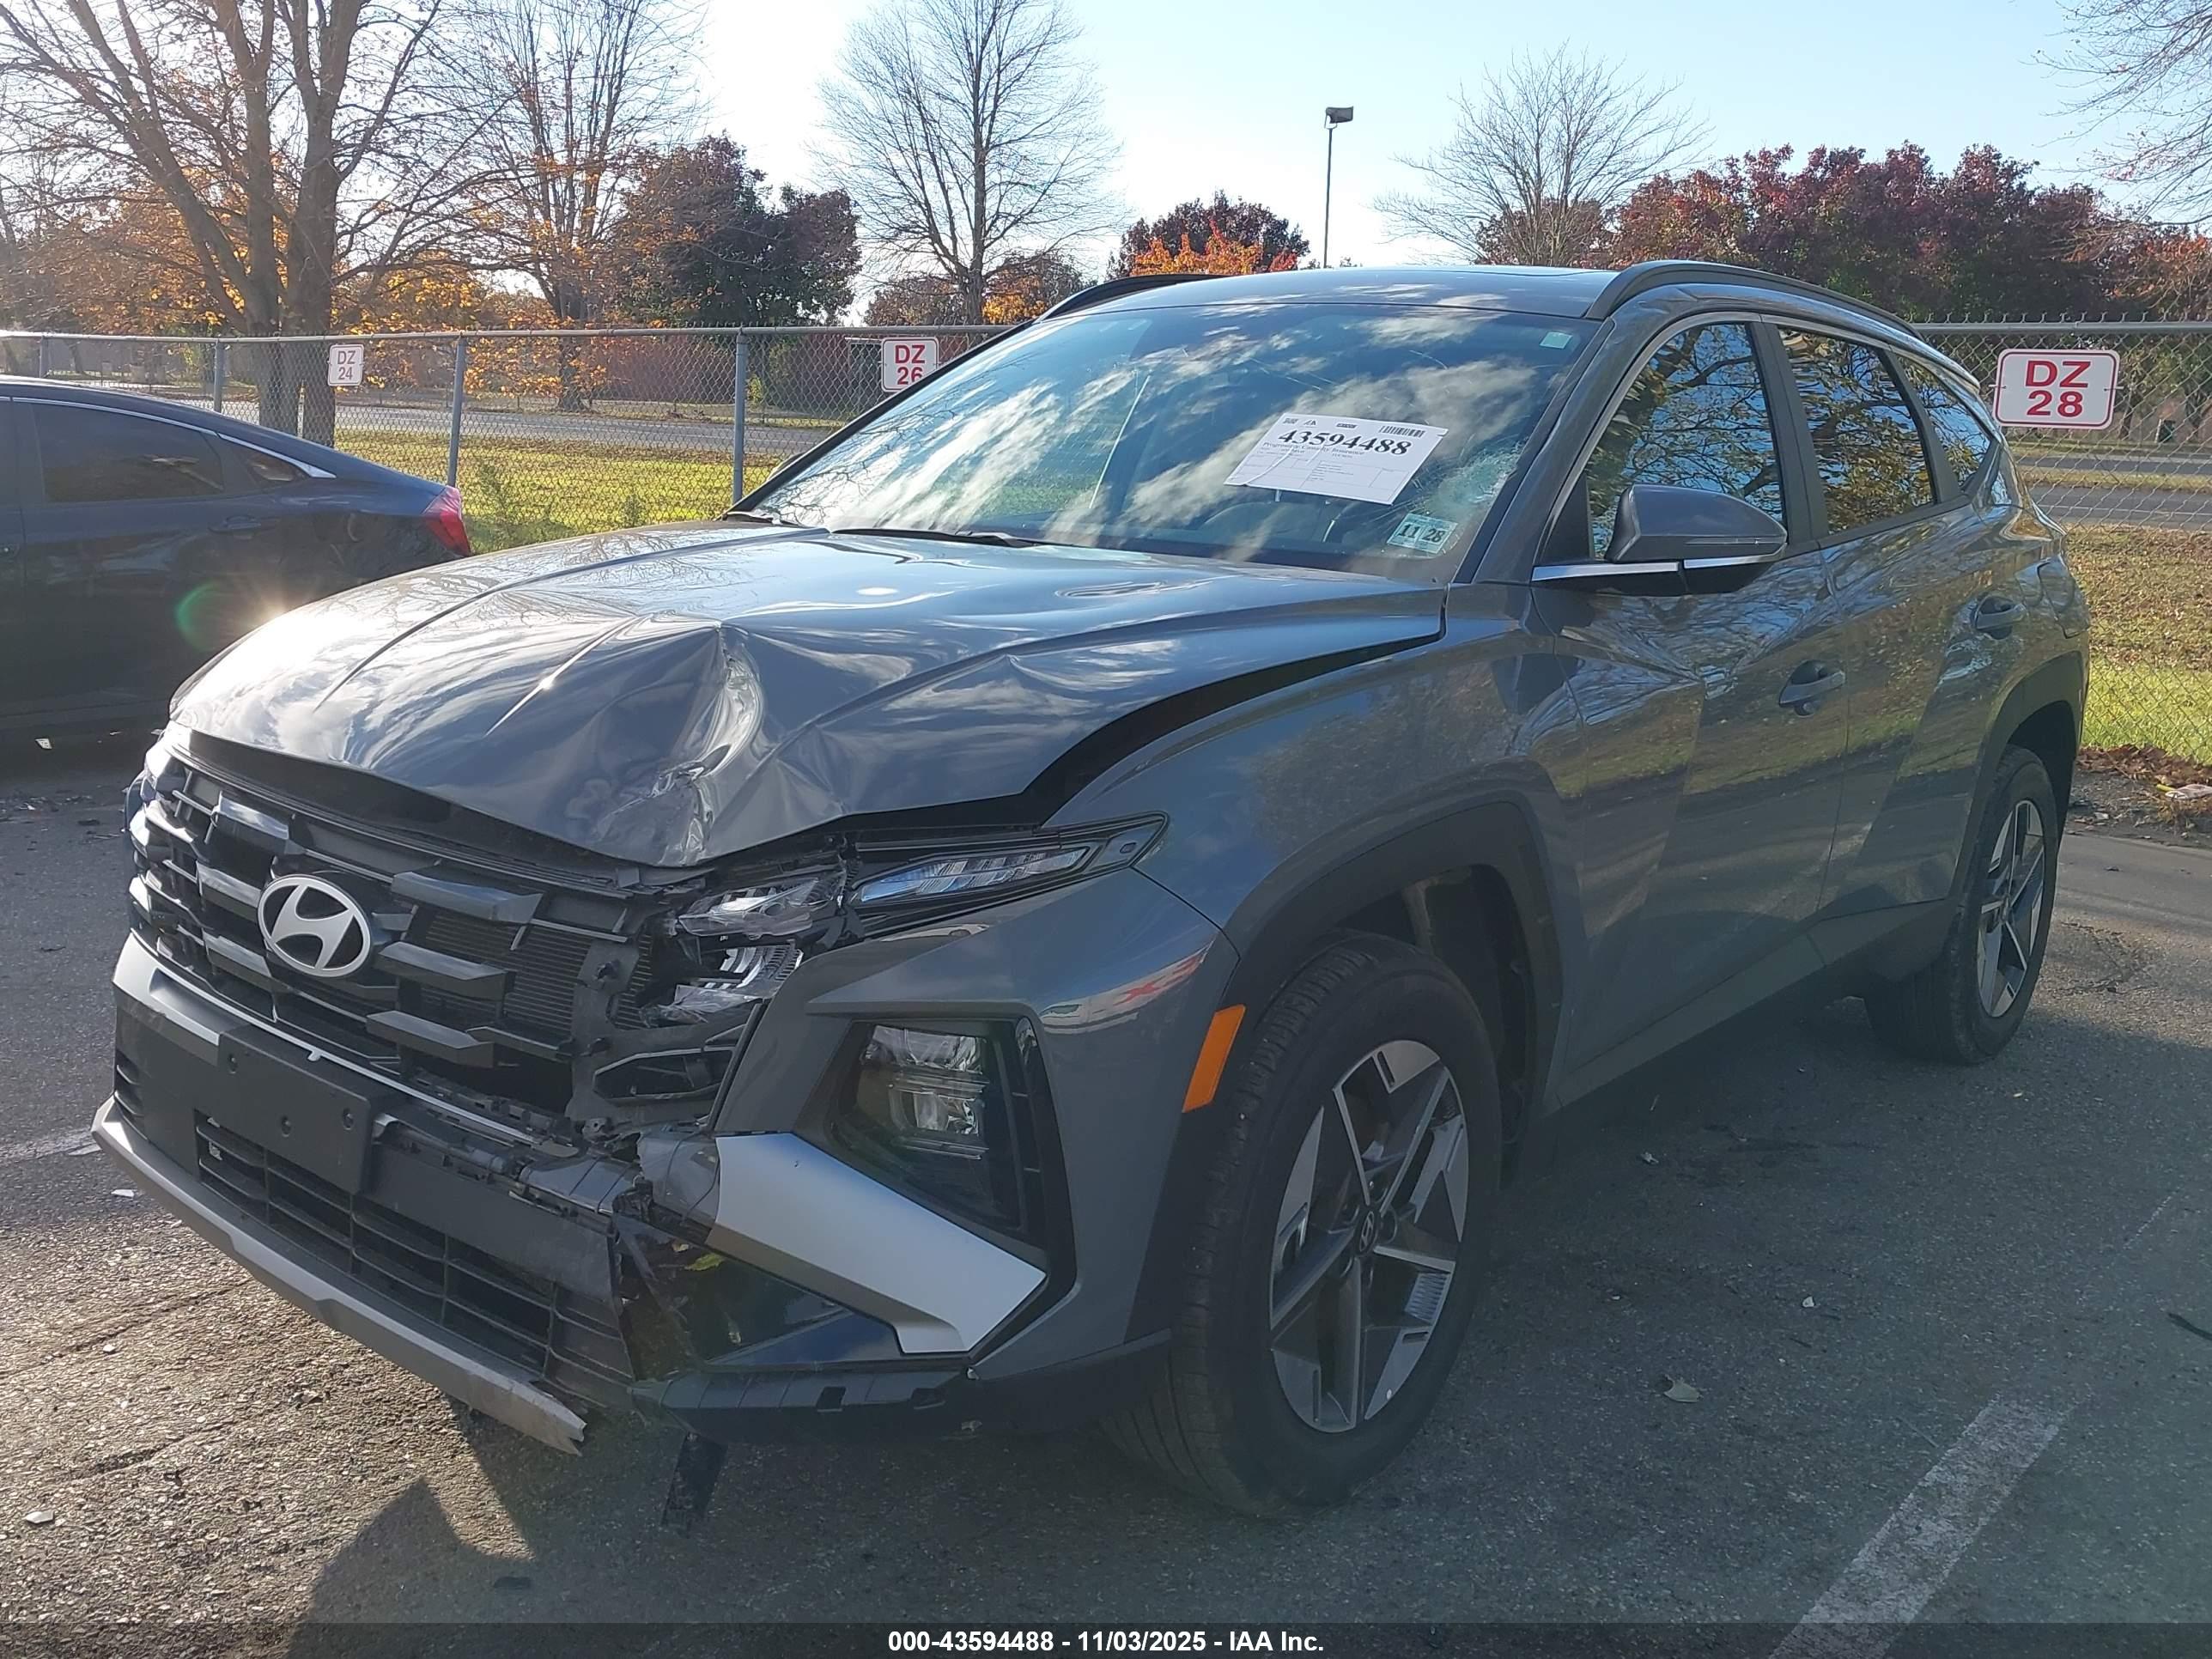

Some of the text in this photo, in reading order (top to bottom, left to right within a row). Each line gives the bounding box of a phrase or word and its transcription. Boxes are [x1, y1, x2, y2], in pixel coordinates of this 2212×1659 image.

[337, 349, 356, 365] DZ
[895, 344, 926, 364] DZ
[337, 367, 353, 380] 24
[2025, 360, 2092, 388] DZ
[2026, 390, 2084, 417] 28
[1278, 429, 1413, 455] 43594488
[1397, 523, 1421, 539] 11
[1421, 527, 1446, 544] 28
